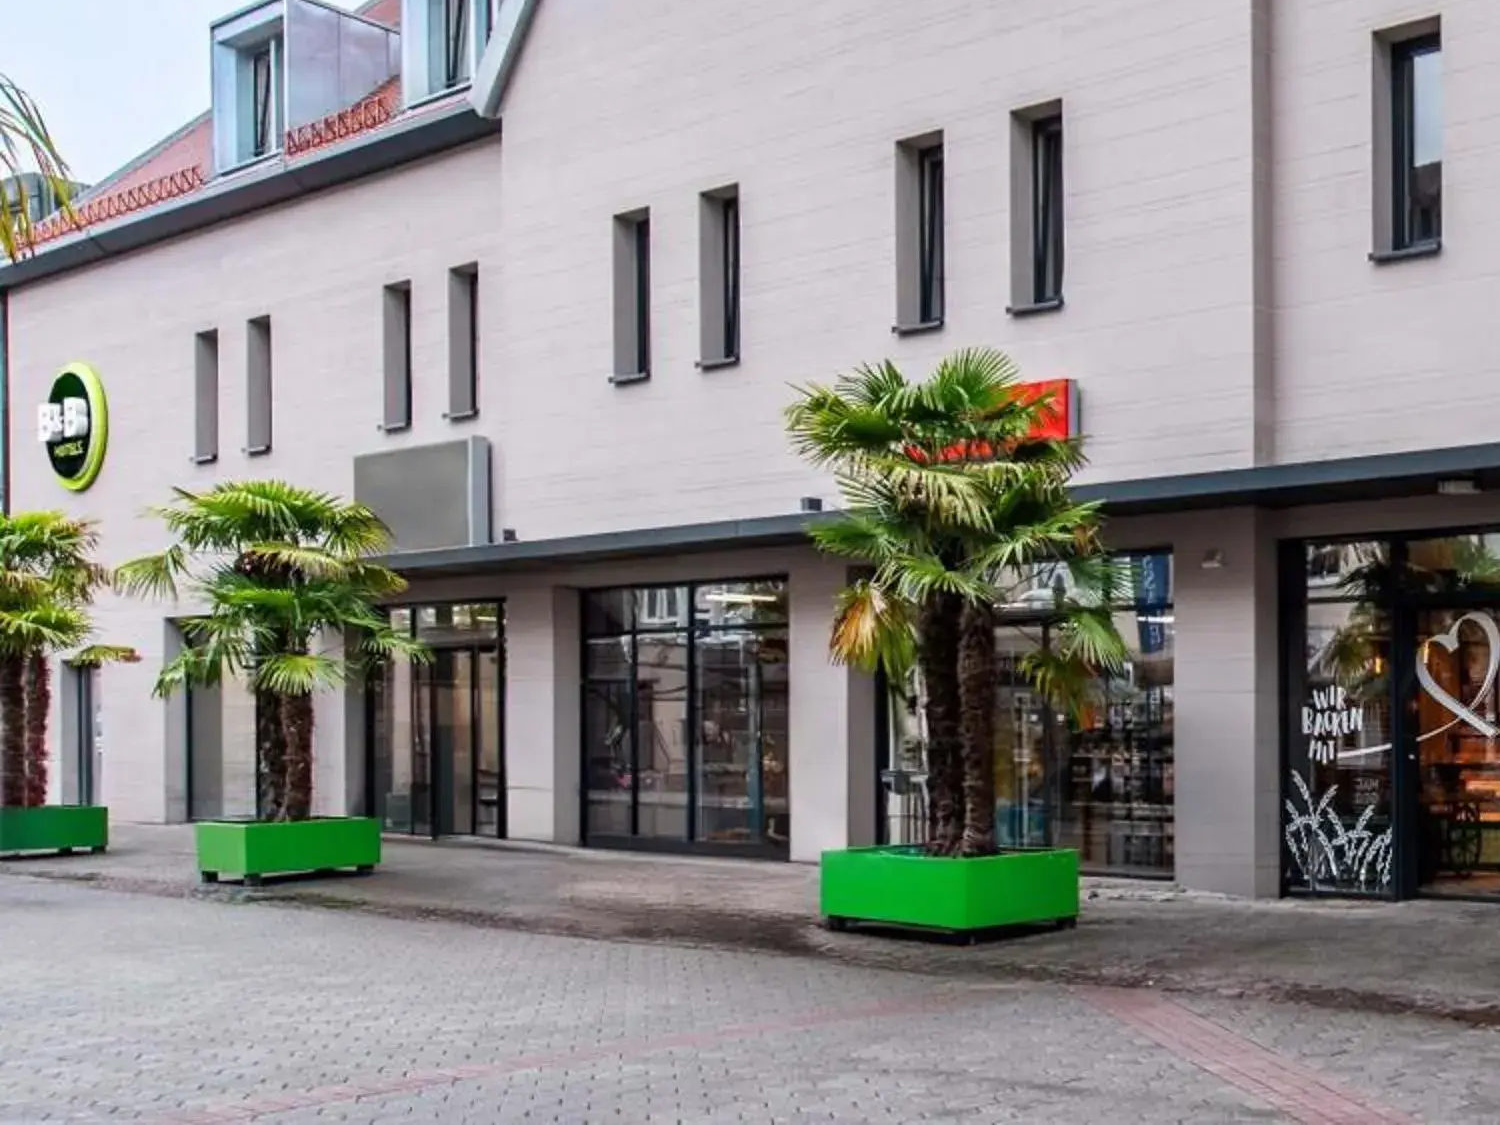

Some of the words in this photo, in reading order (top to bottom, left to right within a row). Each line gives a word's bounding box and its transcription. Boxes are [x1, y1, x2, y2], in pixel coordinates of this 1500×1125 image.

[1312, 684, 1347, 710] WIR
[1301, 706, 1363, 737] BACKEN
[1308, 739, 1336, 765] MIT
